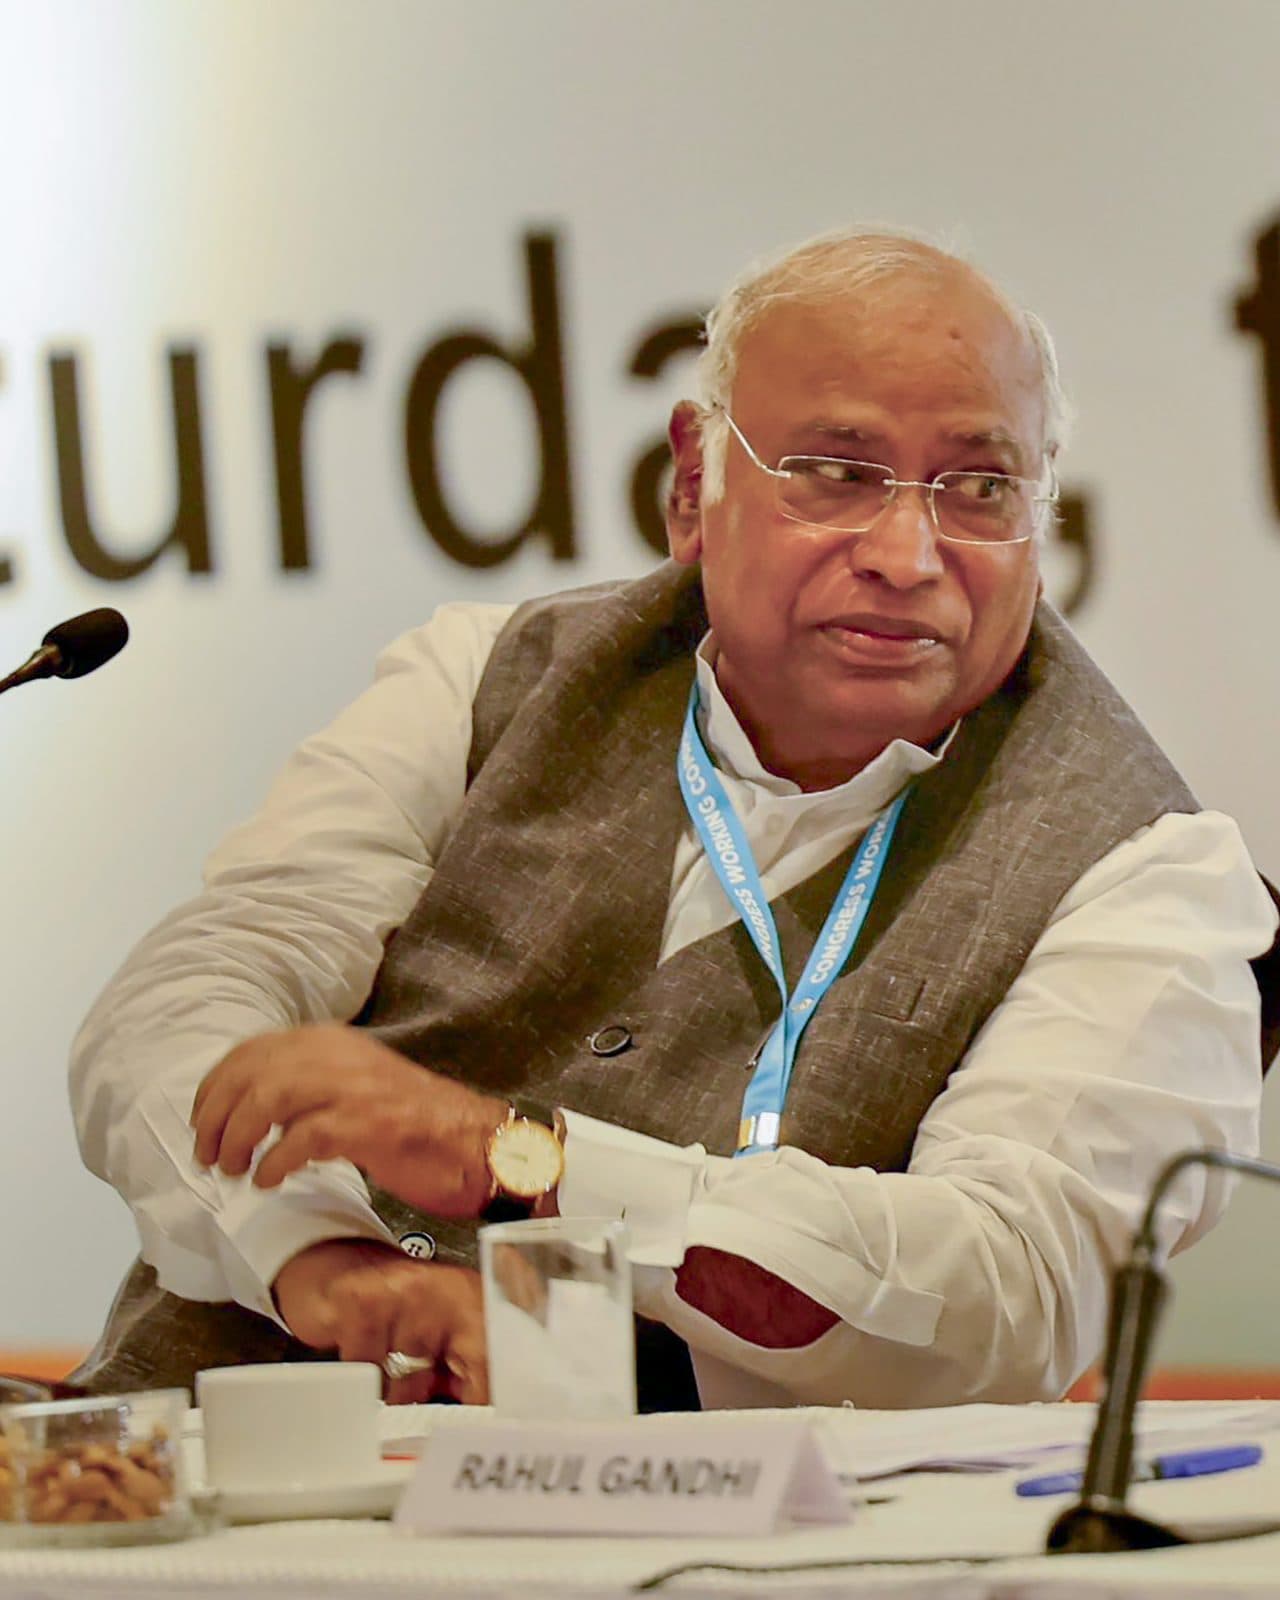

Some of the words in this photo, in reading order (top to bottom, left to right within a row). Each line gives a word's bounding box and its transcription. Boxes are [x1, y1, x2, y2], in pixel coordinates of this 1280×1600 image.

[698, 795, 746, 884] WORKING
[810, 882, 867, 984] CONGRESS
[453, 1452, 588, 1493] RAHUL
[597, 1454, 762, 1497] GANDHI
